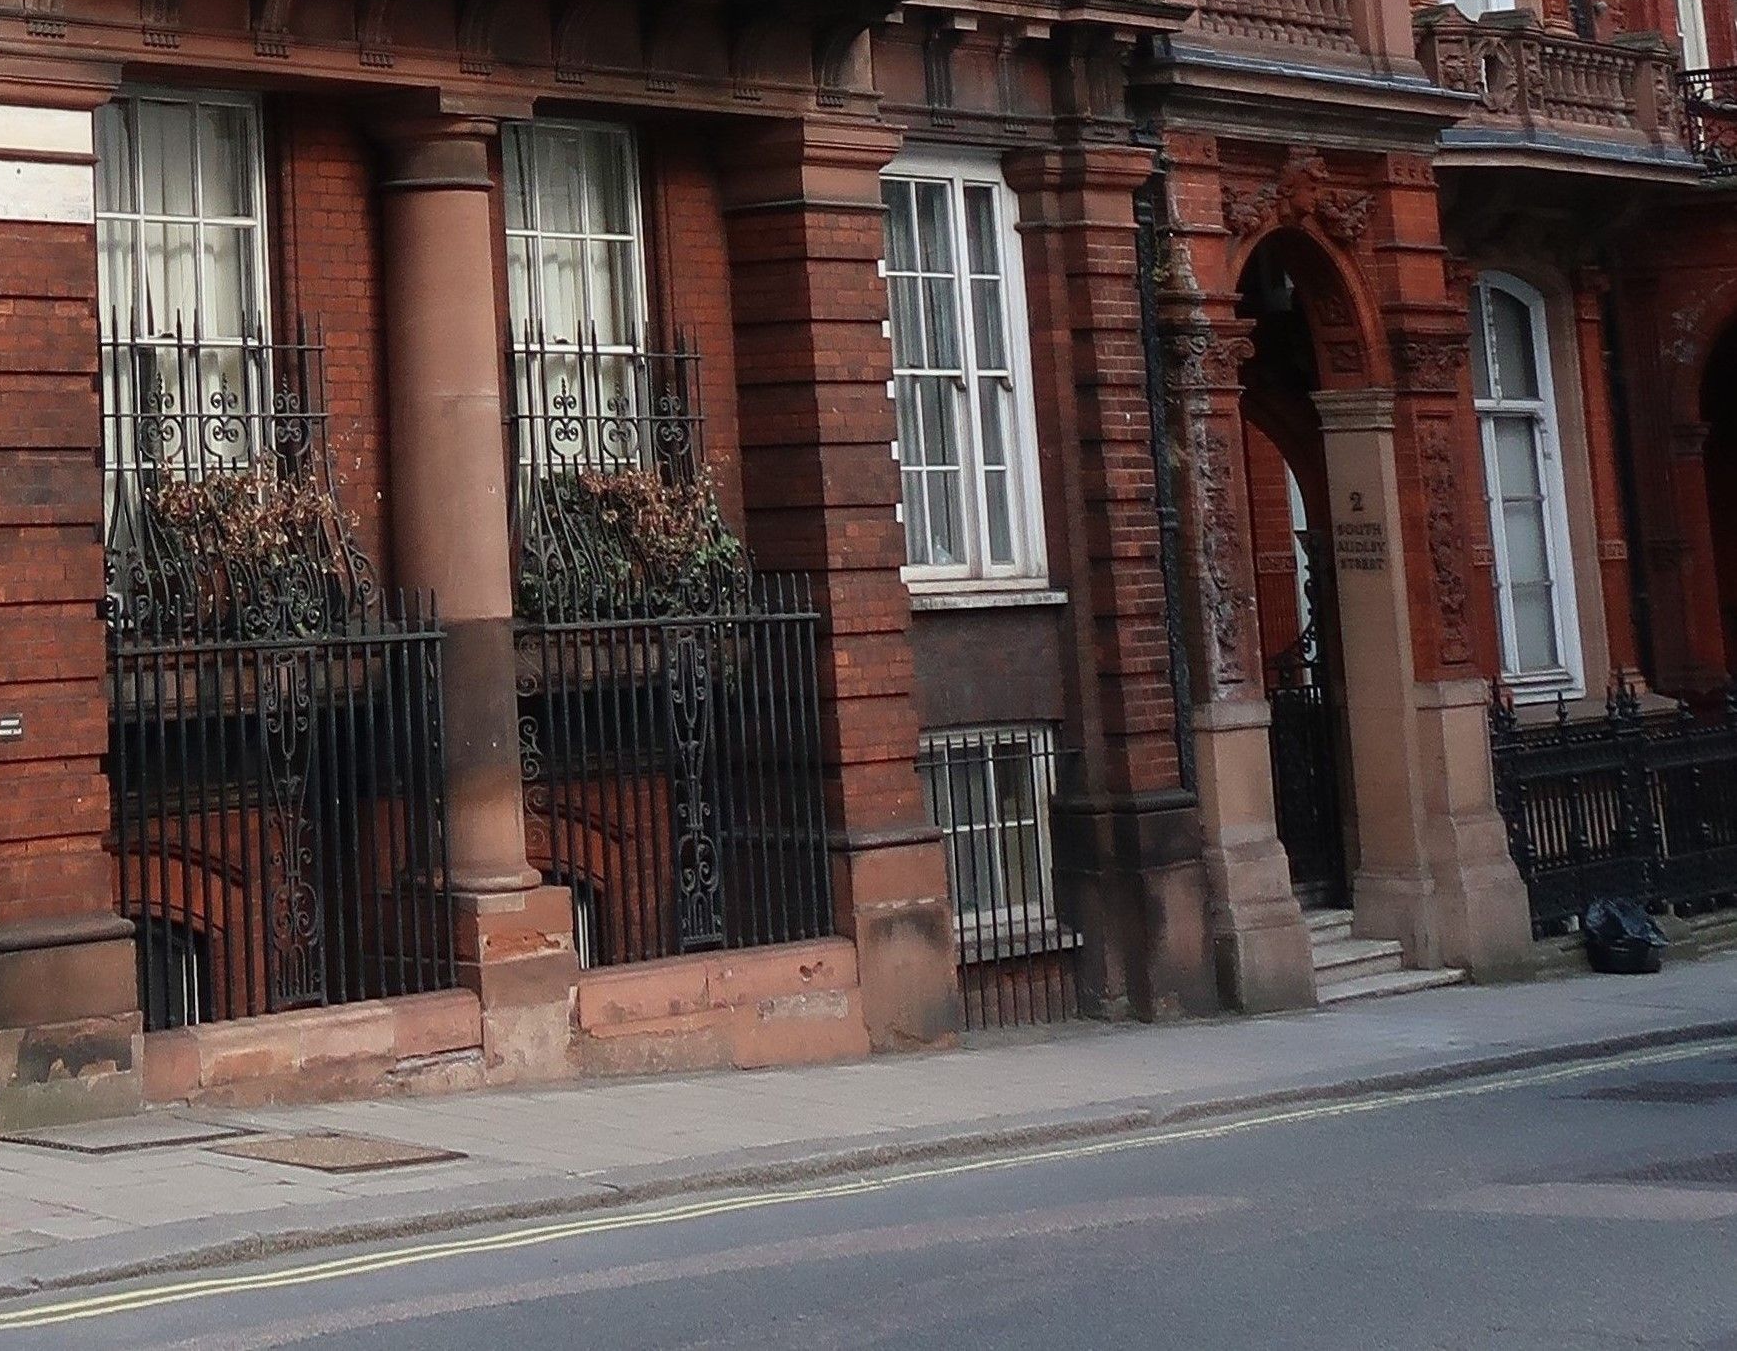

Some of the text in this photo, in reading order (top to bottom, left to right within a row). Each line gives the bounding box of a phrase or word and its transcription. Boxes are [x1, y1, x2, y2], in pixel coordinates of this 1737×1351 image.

[1349, 491, 1363, 512] 2
[1337, 522, 1383, 536] SOUTH
[1336, 539, 1387, 553] AUDLEY
[1340, 557, 1386, 570] STREET
